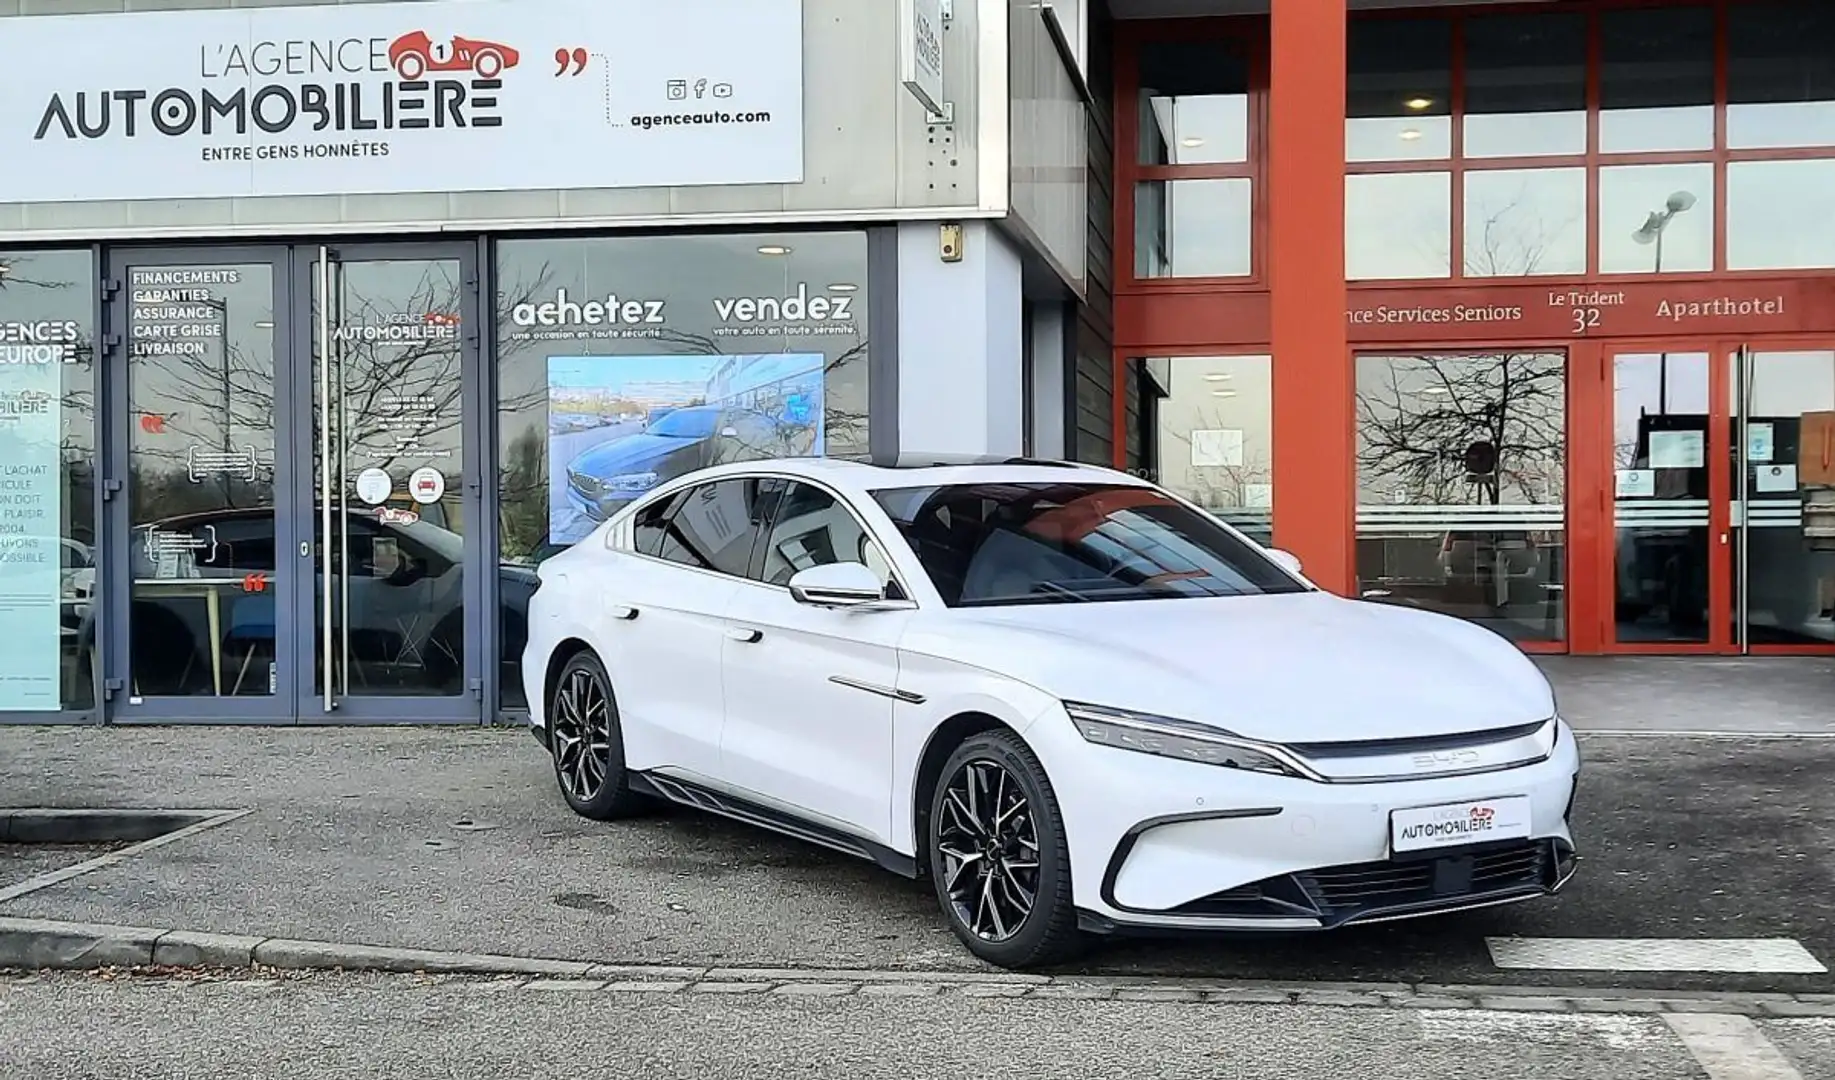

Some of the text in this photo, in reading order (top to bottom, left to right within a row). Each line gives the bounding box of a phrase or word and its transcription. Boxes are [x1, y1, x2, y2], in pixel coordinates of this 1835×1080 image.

[200, 37, 389, 79] L'AGENCE
[33, 79, 503, 140] AUTOMOBILIERE
[630, 109, 771, 129] agenceauto.com
[201, 139, 390, 161] ENTRE GENS HONNÊTES
[132, 270, 238, 285] FINANCEMENTS
[132, 289, 209, 302] GARANTIES
[713, 282, 852, 321] vendez
[1548, 291, 1625, 306] Le Trident
[132, 307, 214, 320] ASSURANCE
[512, 288, 665, 326] achetez
[1376, 305, 1451, 323] Services
[1454, 304, 1522, 321] Seniors
[1656, 296, 1786, 321] Aparthotel
[1572, 308, 1600, 333] 32
[133, 324, 222, 338] CARTE GRISE
[512, 332, 530, 340] une
[533, 329, 574, 339] occasion
[577, 331, 589, 339] en
[592, 328, 618, 339] toute
[712, 327, 739, 336] votre
[742, 326, 766, 335] auto
[768, 327, 781, 335] en
[784, 326, 810, 335] toute
[133, 342, 205, 355] LIVRAISON
